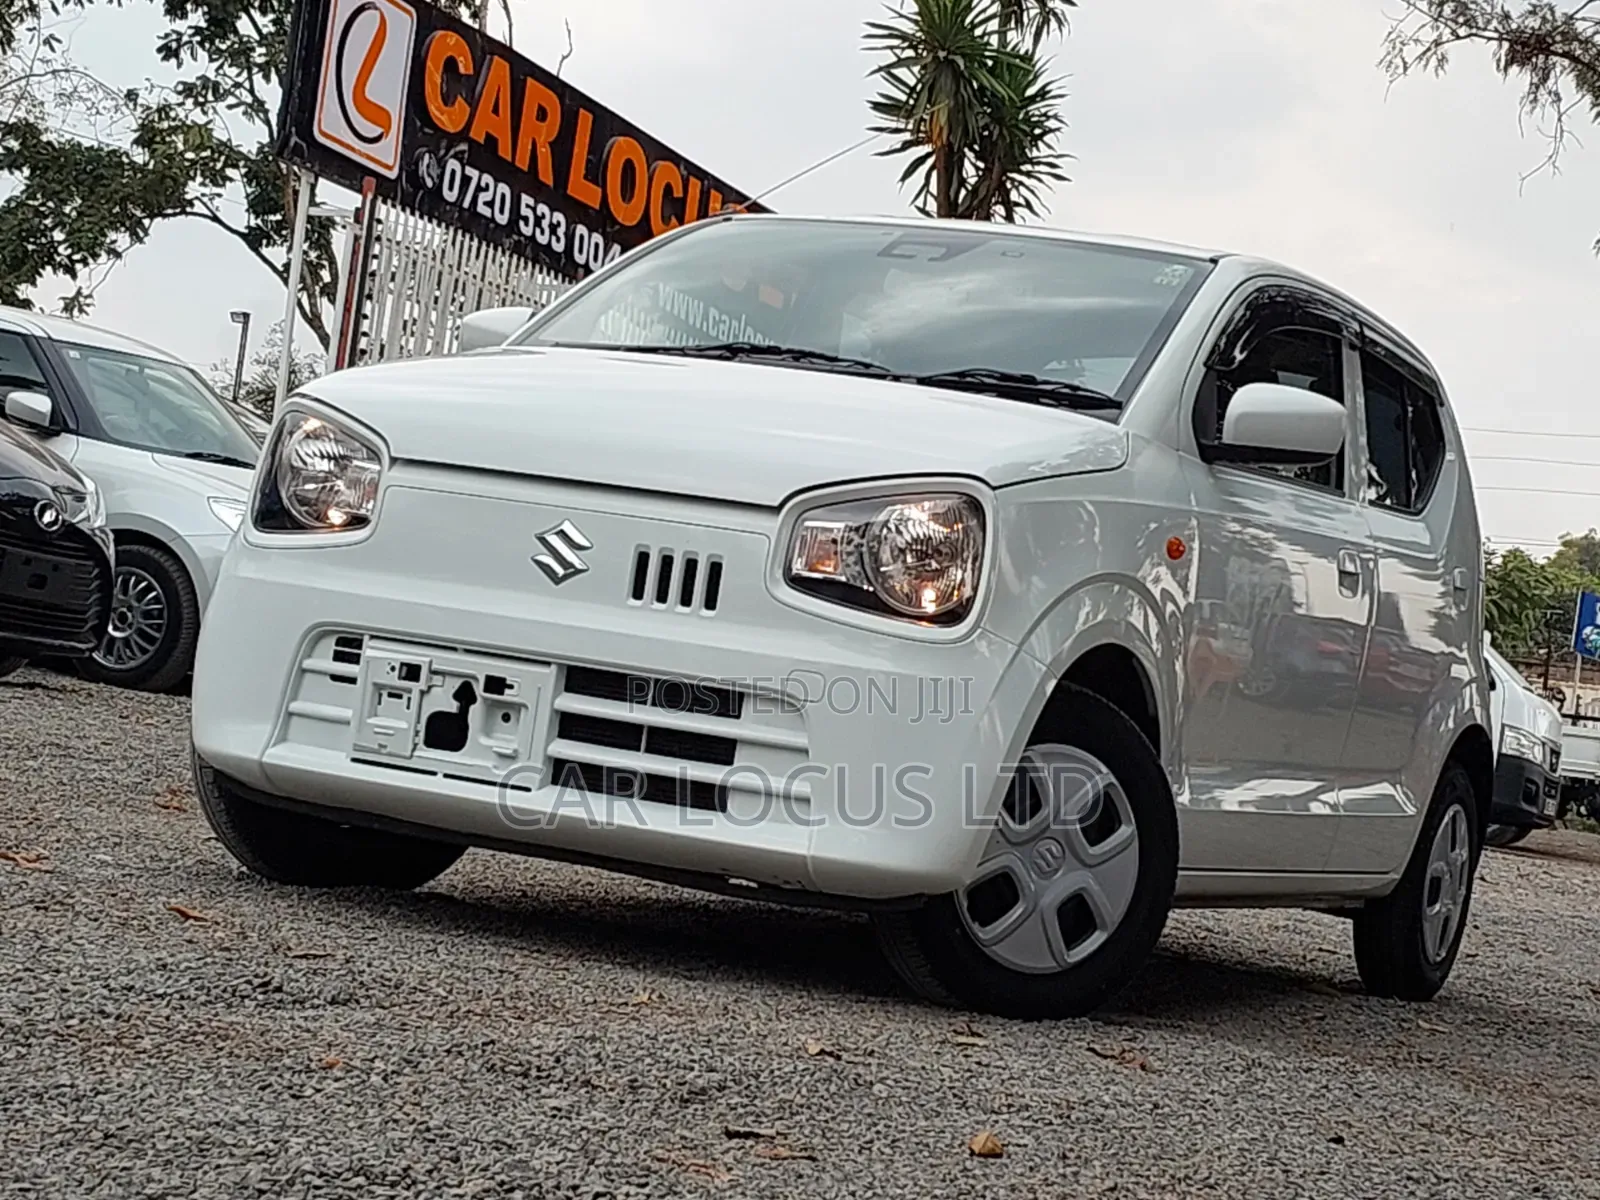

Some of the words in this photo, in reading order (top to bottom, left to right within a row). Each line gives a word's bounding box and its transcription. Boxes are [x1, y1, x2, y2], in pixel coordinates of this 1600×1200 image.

[424, 30, 561, 187] CAR
[442, 158, 511, 226] 0720
[519, 192, 567, 253] 533
